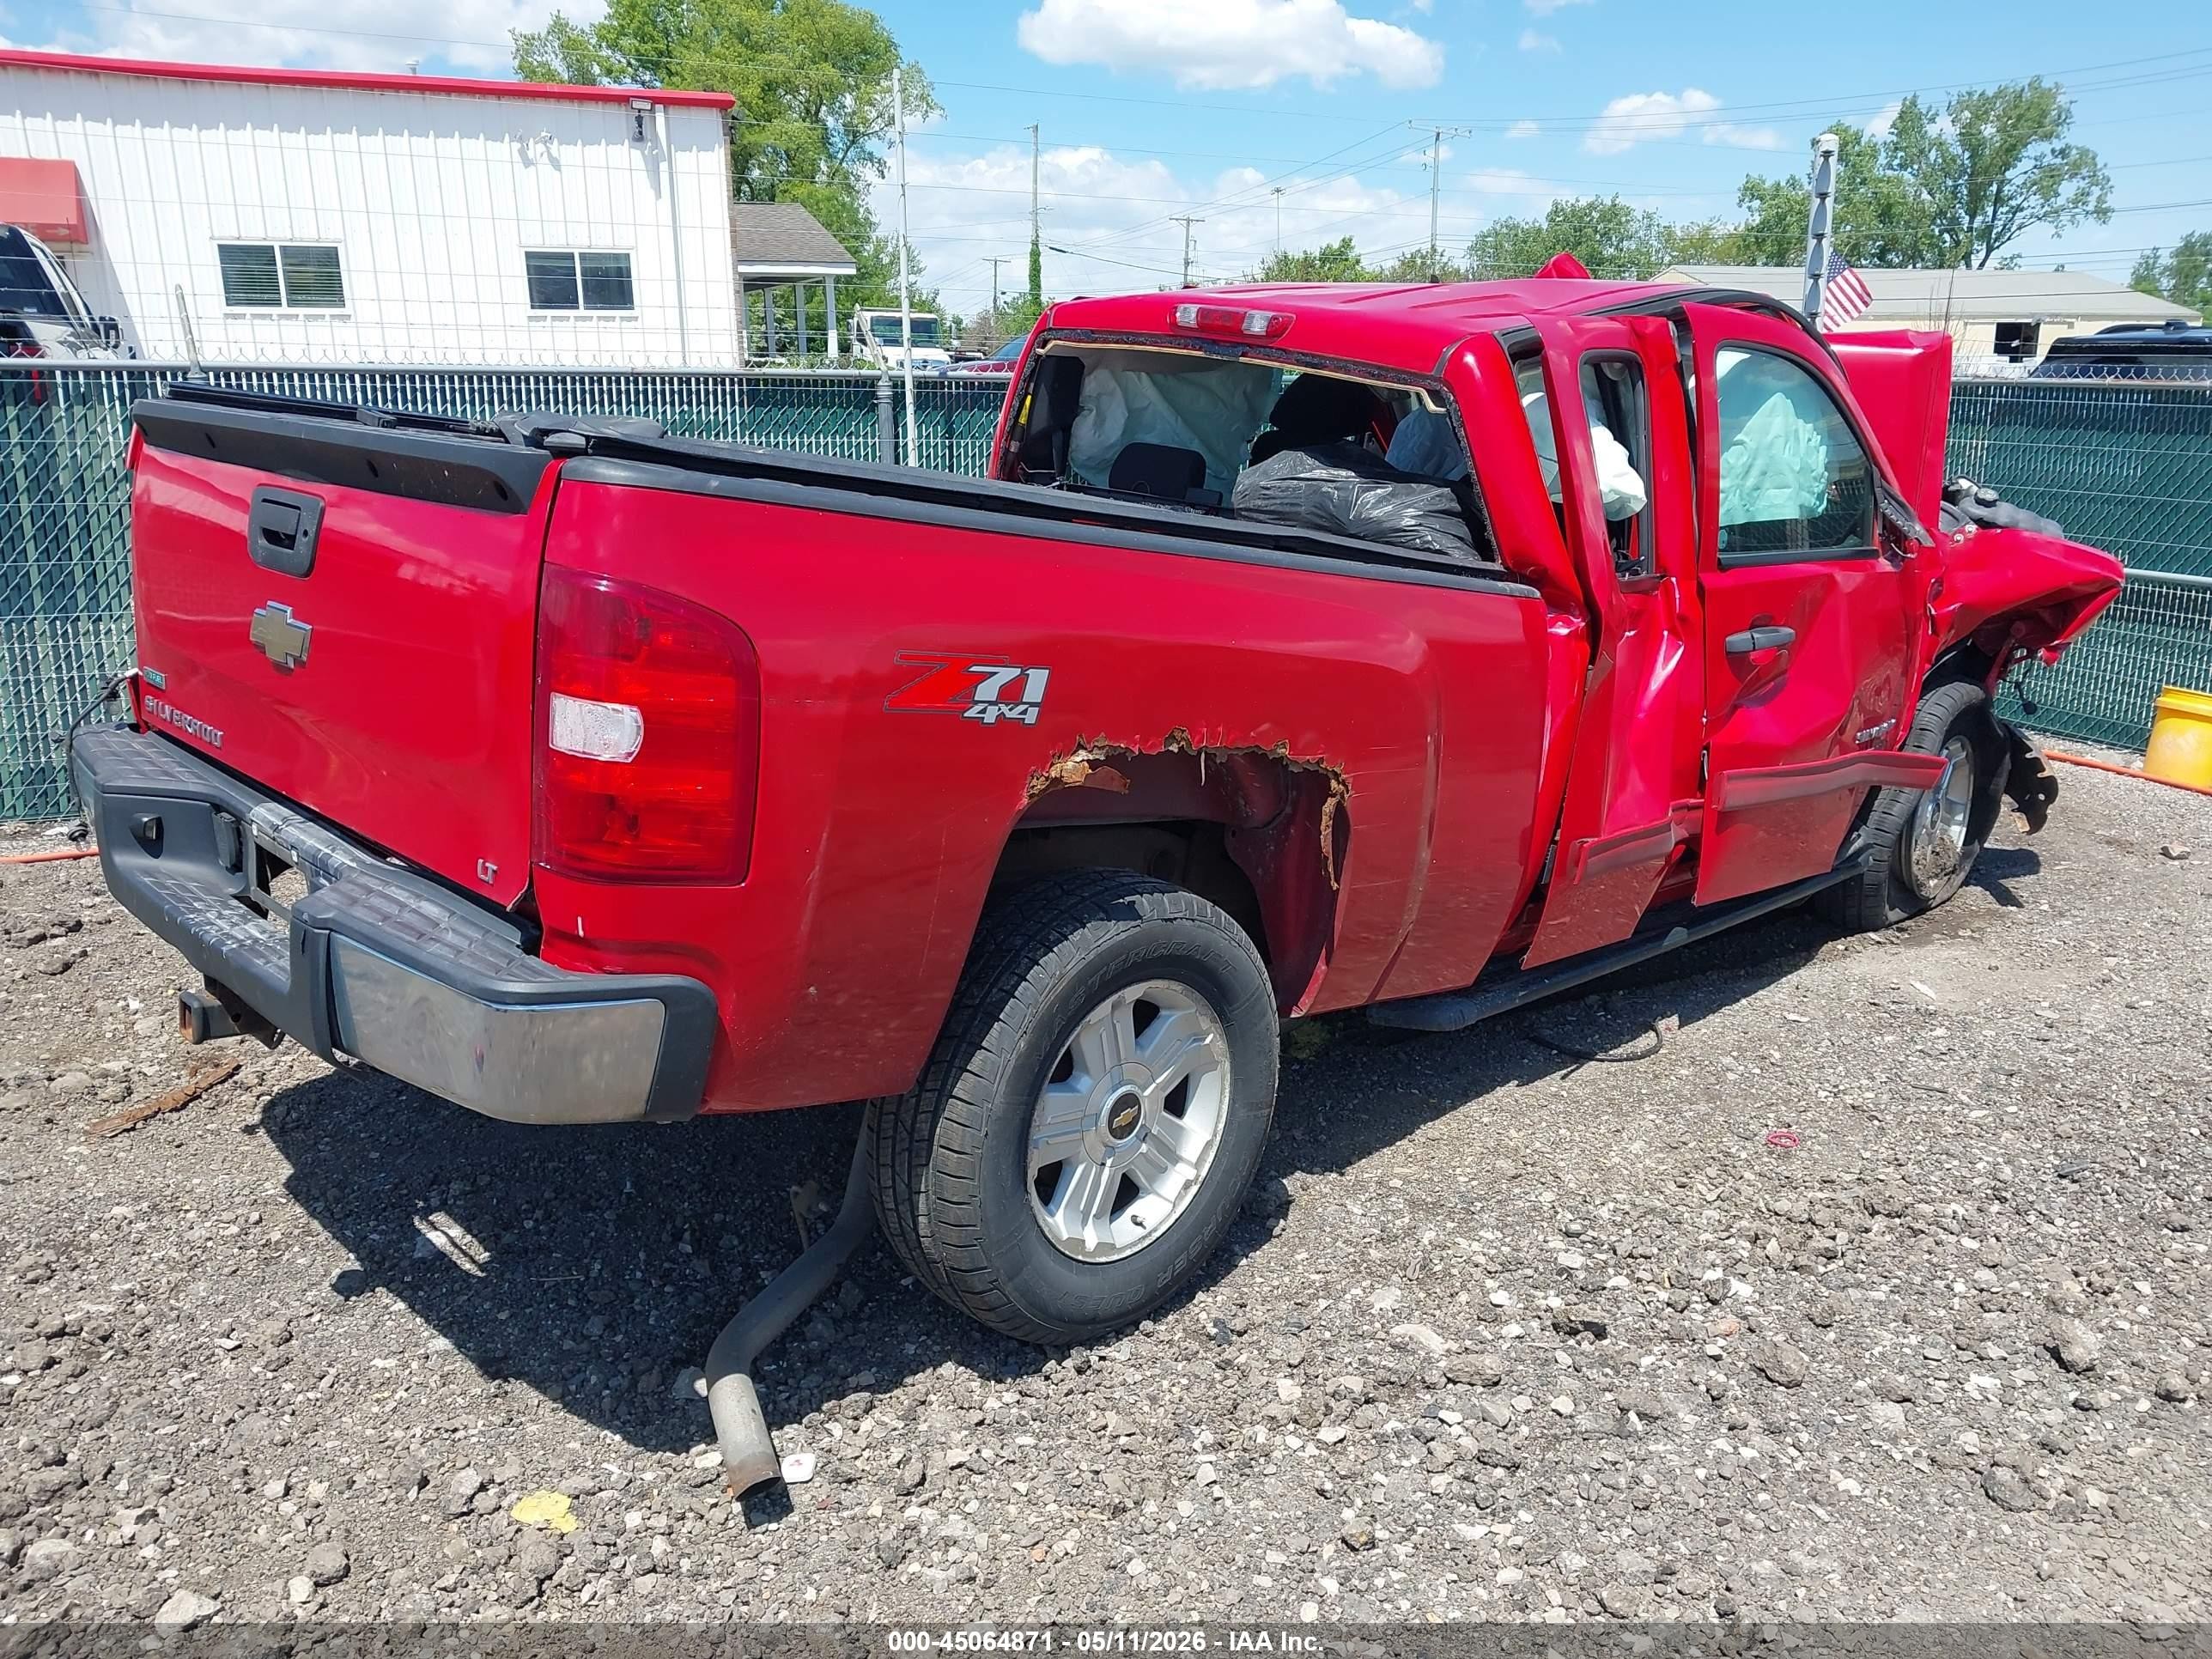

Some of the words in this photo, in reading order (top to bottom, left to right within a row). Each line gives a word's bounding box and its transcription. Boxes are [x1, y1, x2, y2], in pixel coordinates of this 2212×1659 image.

[884, 650, 1052, 713] Z71
[144, 695, 224, 748] SILVERADO
[477, 858, 498, 884] LT
